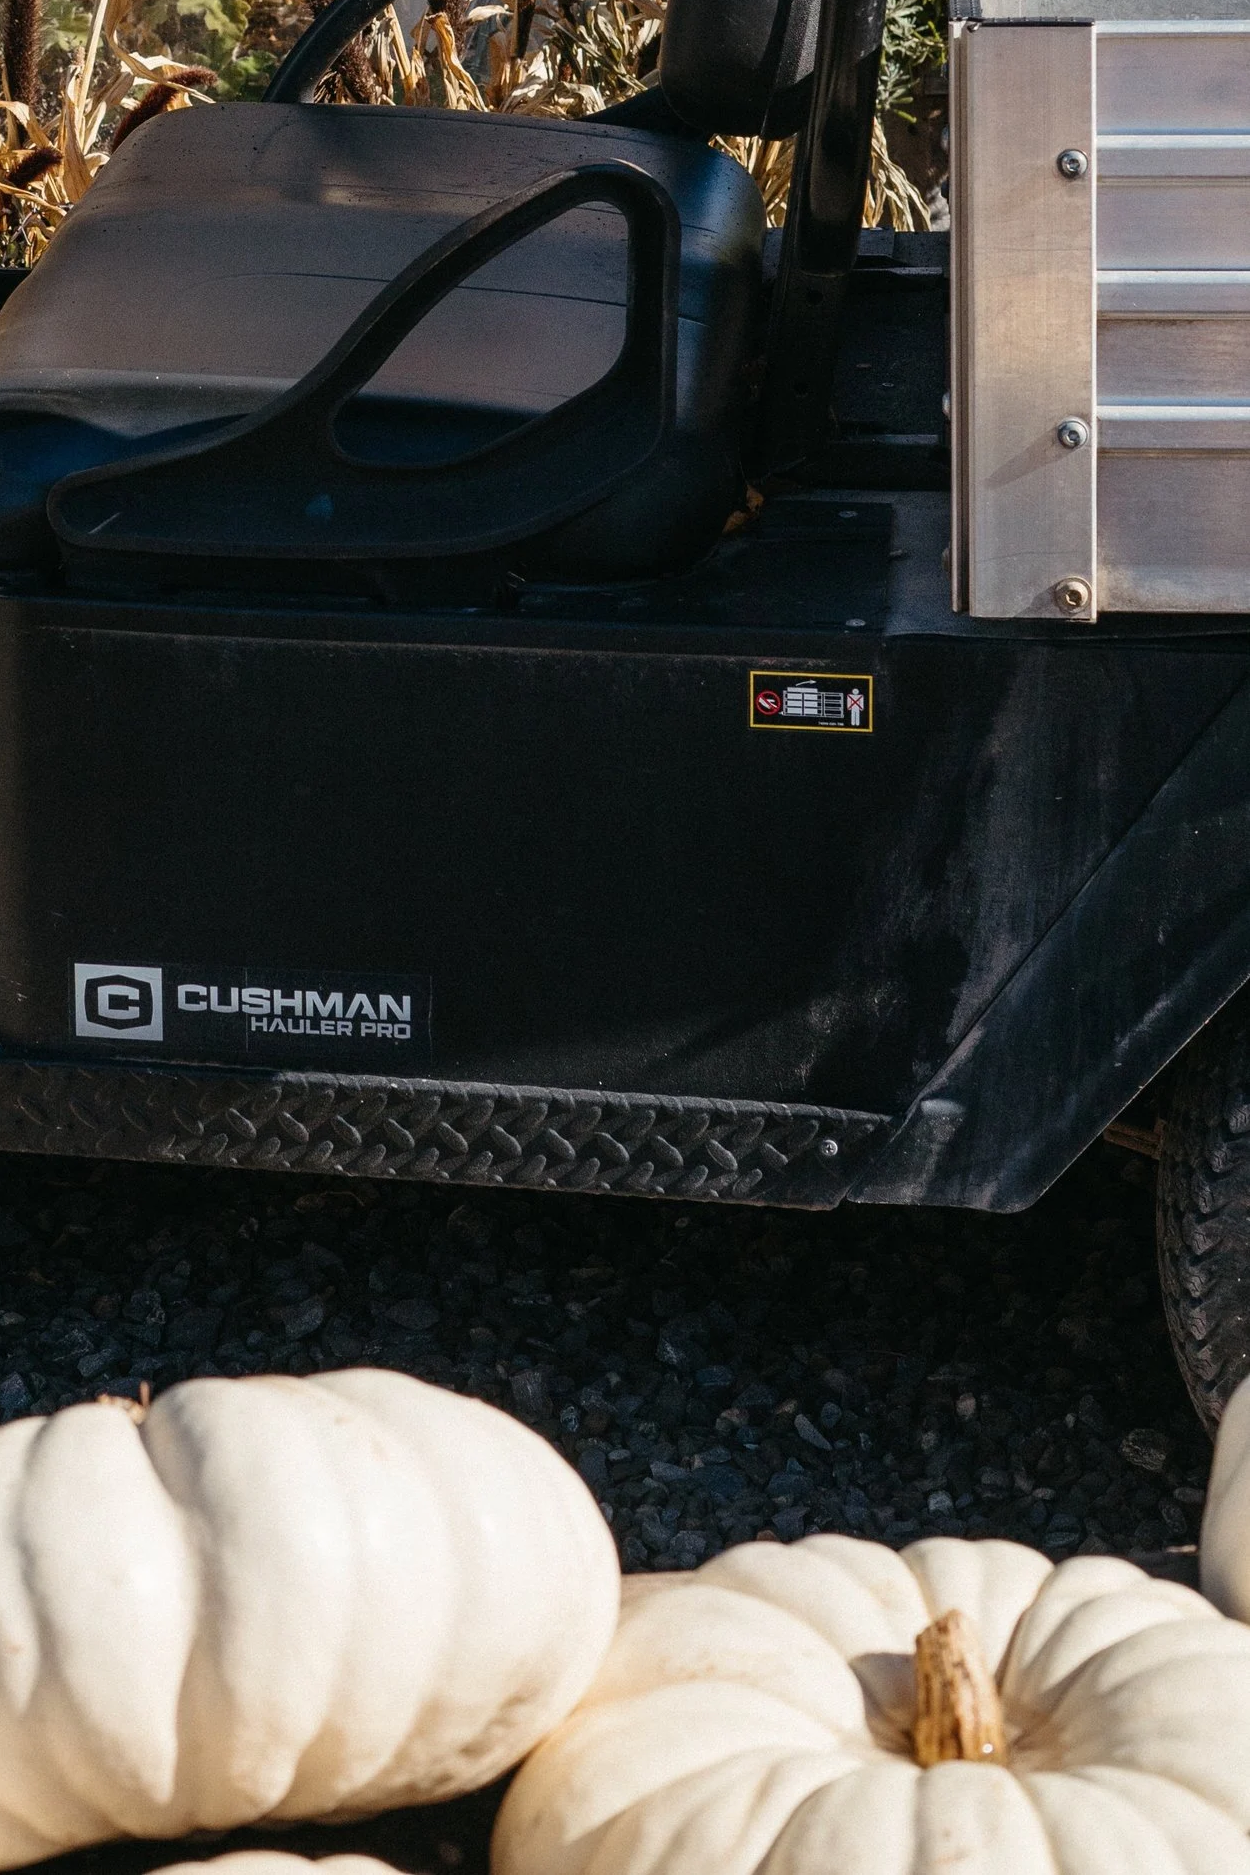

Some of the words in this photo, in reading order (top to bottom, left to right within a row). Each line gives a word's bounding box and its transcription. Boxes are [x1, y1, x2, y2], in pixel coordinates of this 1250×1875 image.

[177, 983, 411, 1022] CUSHMAN
[250, 1016, 353, 1037] HAULER
[360, 1022, 411, 1040] PRO
